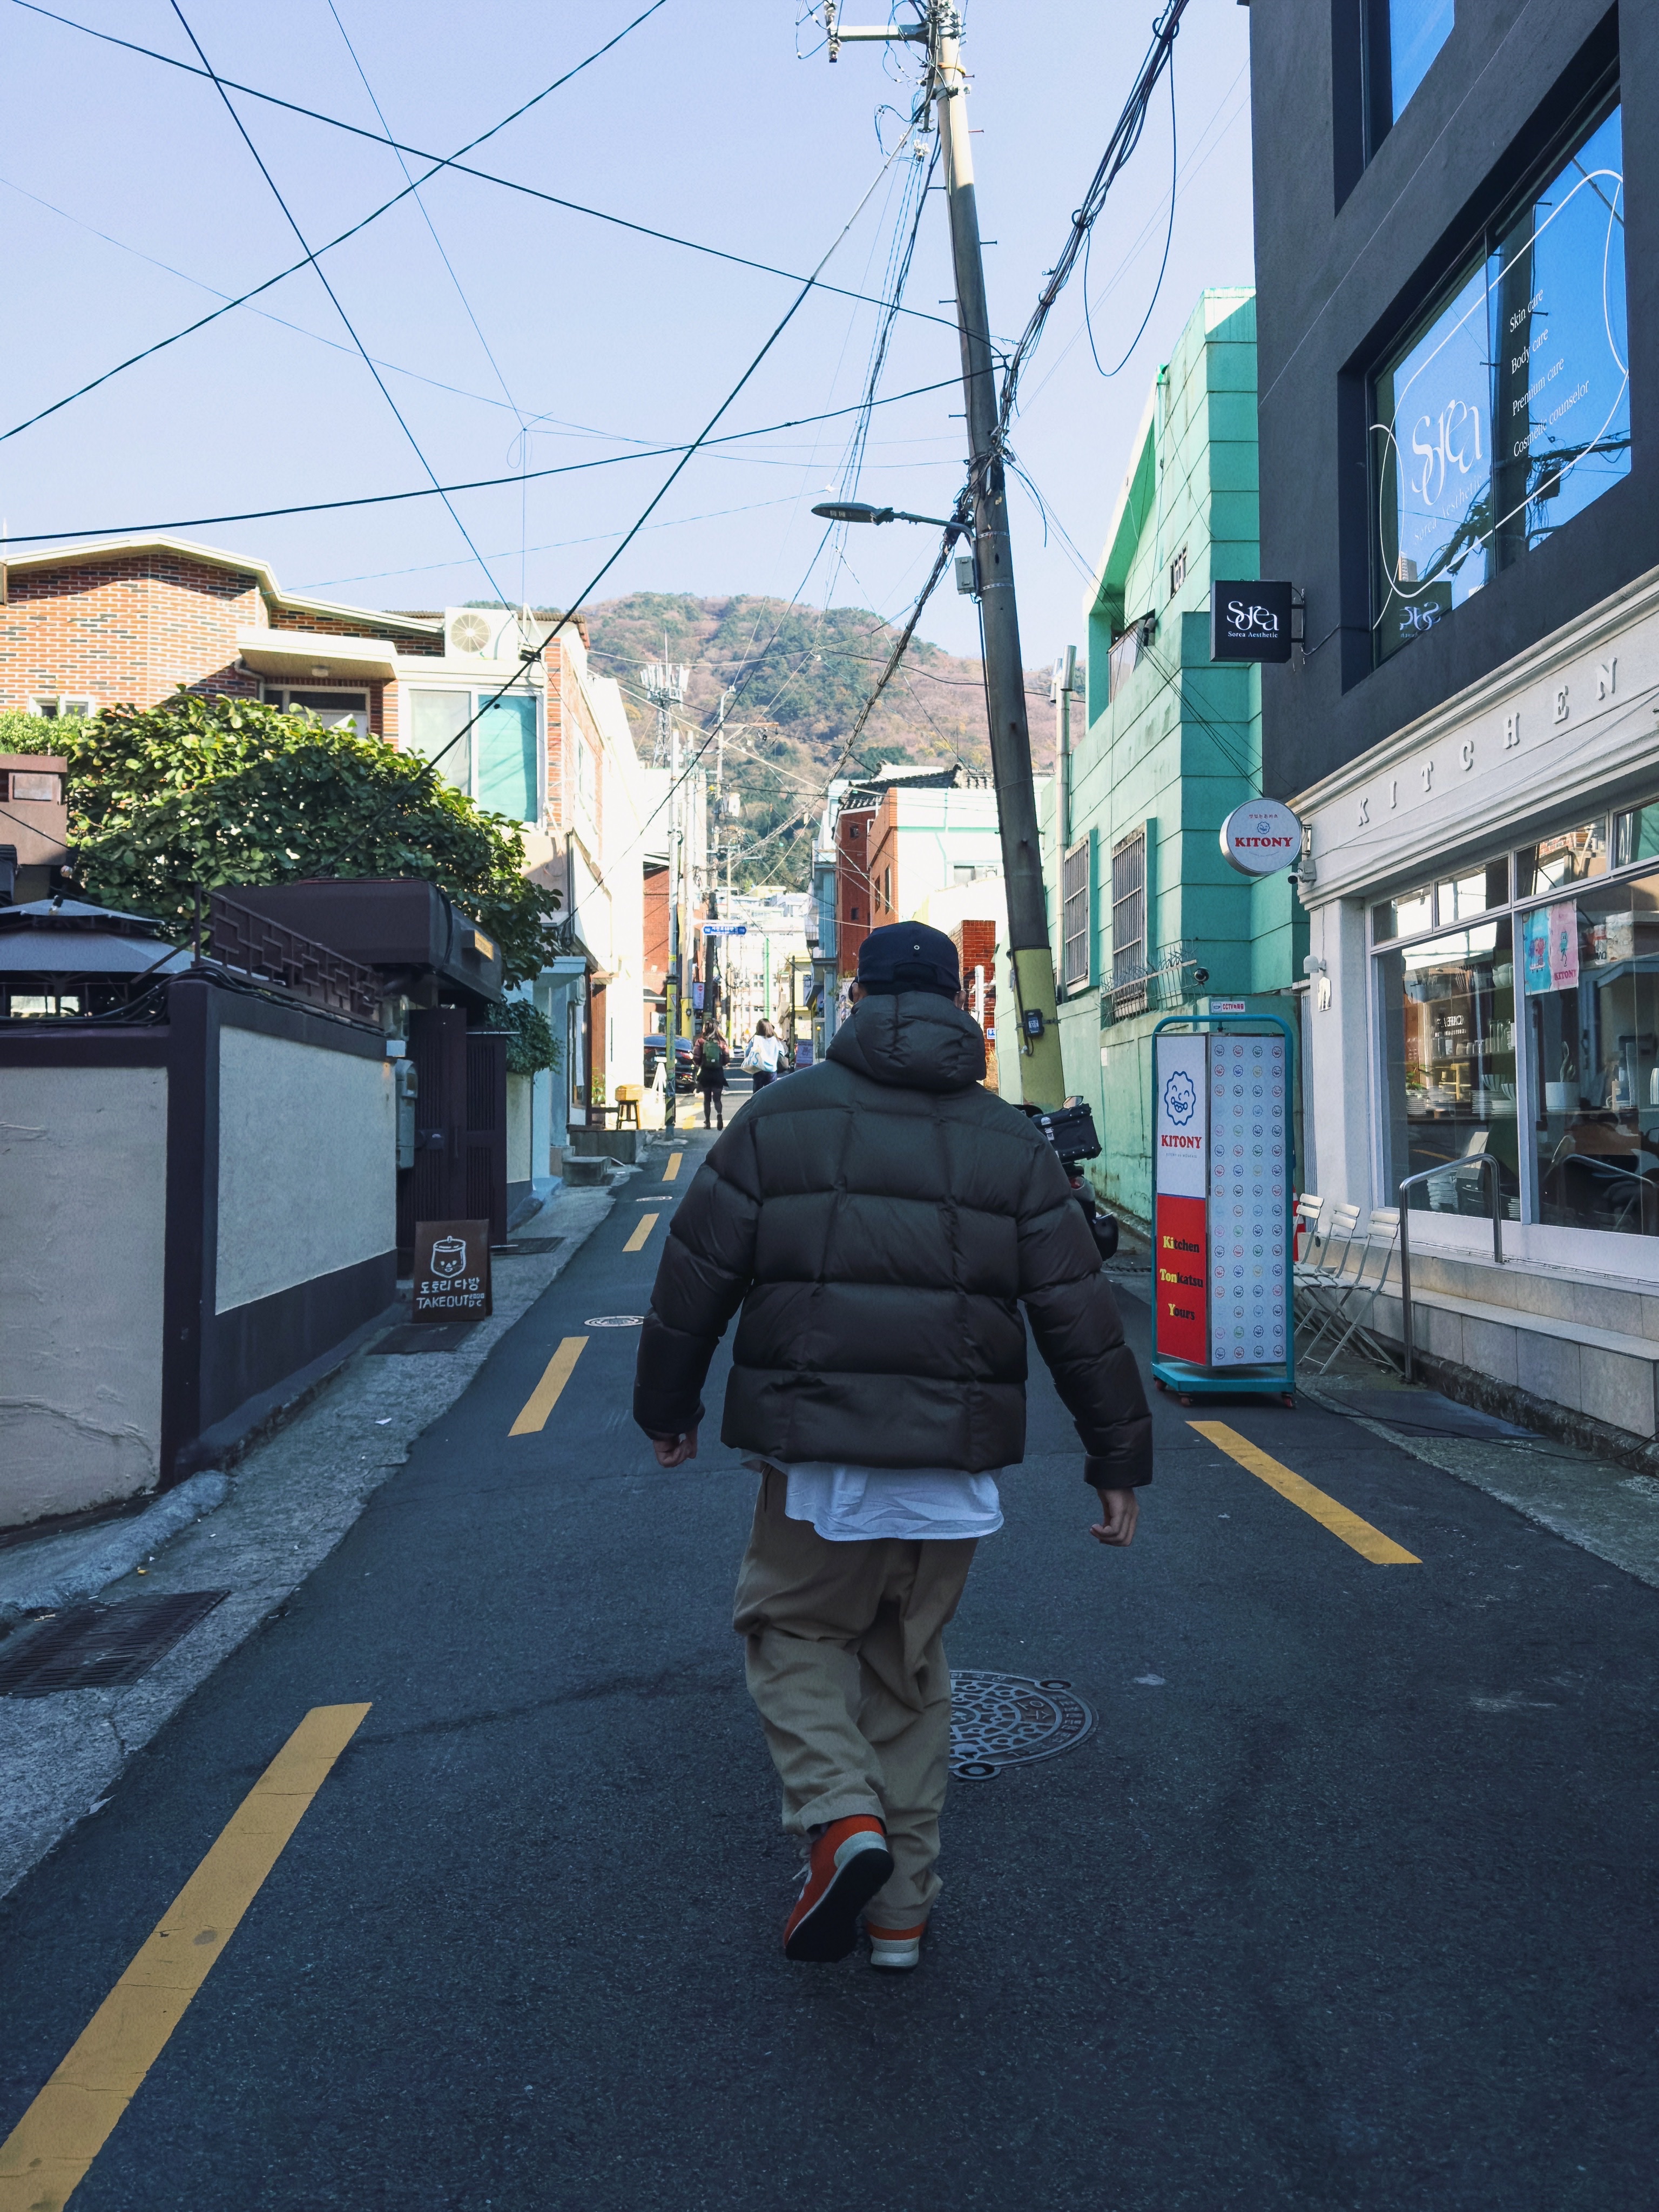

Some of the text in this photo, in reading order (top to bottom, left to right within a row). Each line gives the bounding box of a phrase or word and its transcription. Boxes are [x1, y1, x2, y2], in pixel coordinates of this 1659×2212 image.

[1510, 289, 1543, 333] Skin care
[1512, 328, 1549, 374] Body care
[1513, 358, 1564, 416] Premium care
[1513, 380, 1589, 457] Cosmetic counselor
[1227, 601, 1279, 631] Sorea
[1358, 657, 1617, 826] KITCHEN
[1235, 837, 1293, 847] KITONY
[1554, 969, 1576, 981] KITONY
[1161, 1135, 1202, 1149] KITONY
[1163, 1236, 1200, 1253] Kitchen
[420, 1277, 480, 1294] 도토리 다방
[1159, 1269, 1204, 1288] Tonkatsu
[416, 1294, 469, 1309] TAKEOUT
[1168, 1303, 1195, 1320] Yours
